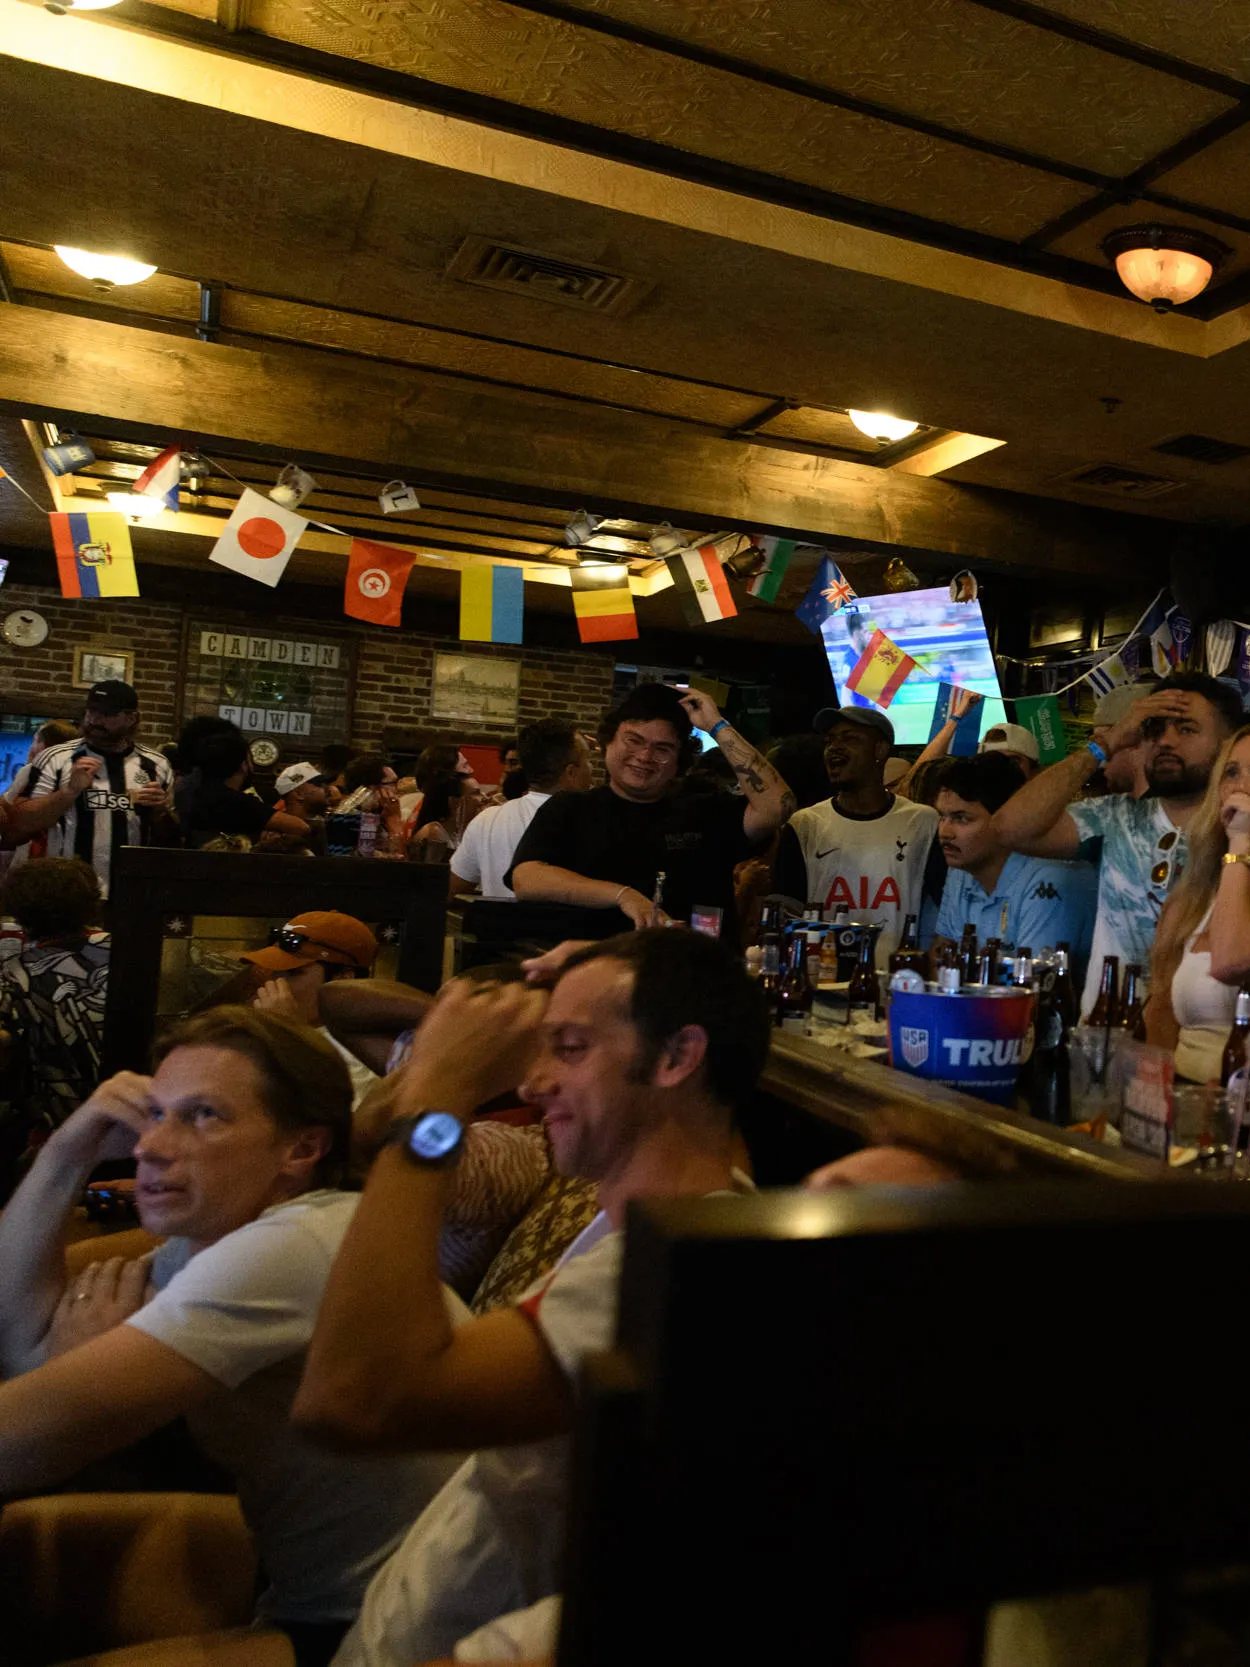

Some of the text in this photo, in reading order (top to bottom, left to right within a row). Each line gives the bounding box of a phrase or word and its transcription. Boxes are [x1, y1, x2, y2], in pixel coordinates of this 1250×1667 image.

[207, 635, 334, 666] CAMDEN
[224, 708, 306, 732] TOWN
[824, 875, 901, 911] AIA
[902, 1029, 927, 1046] USA
